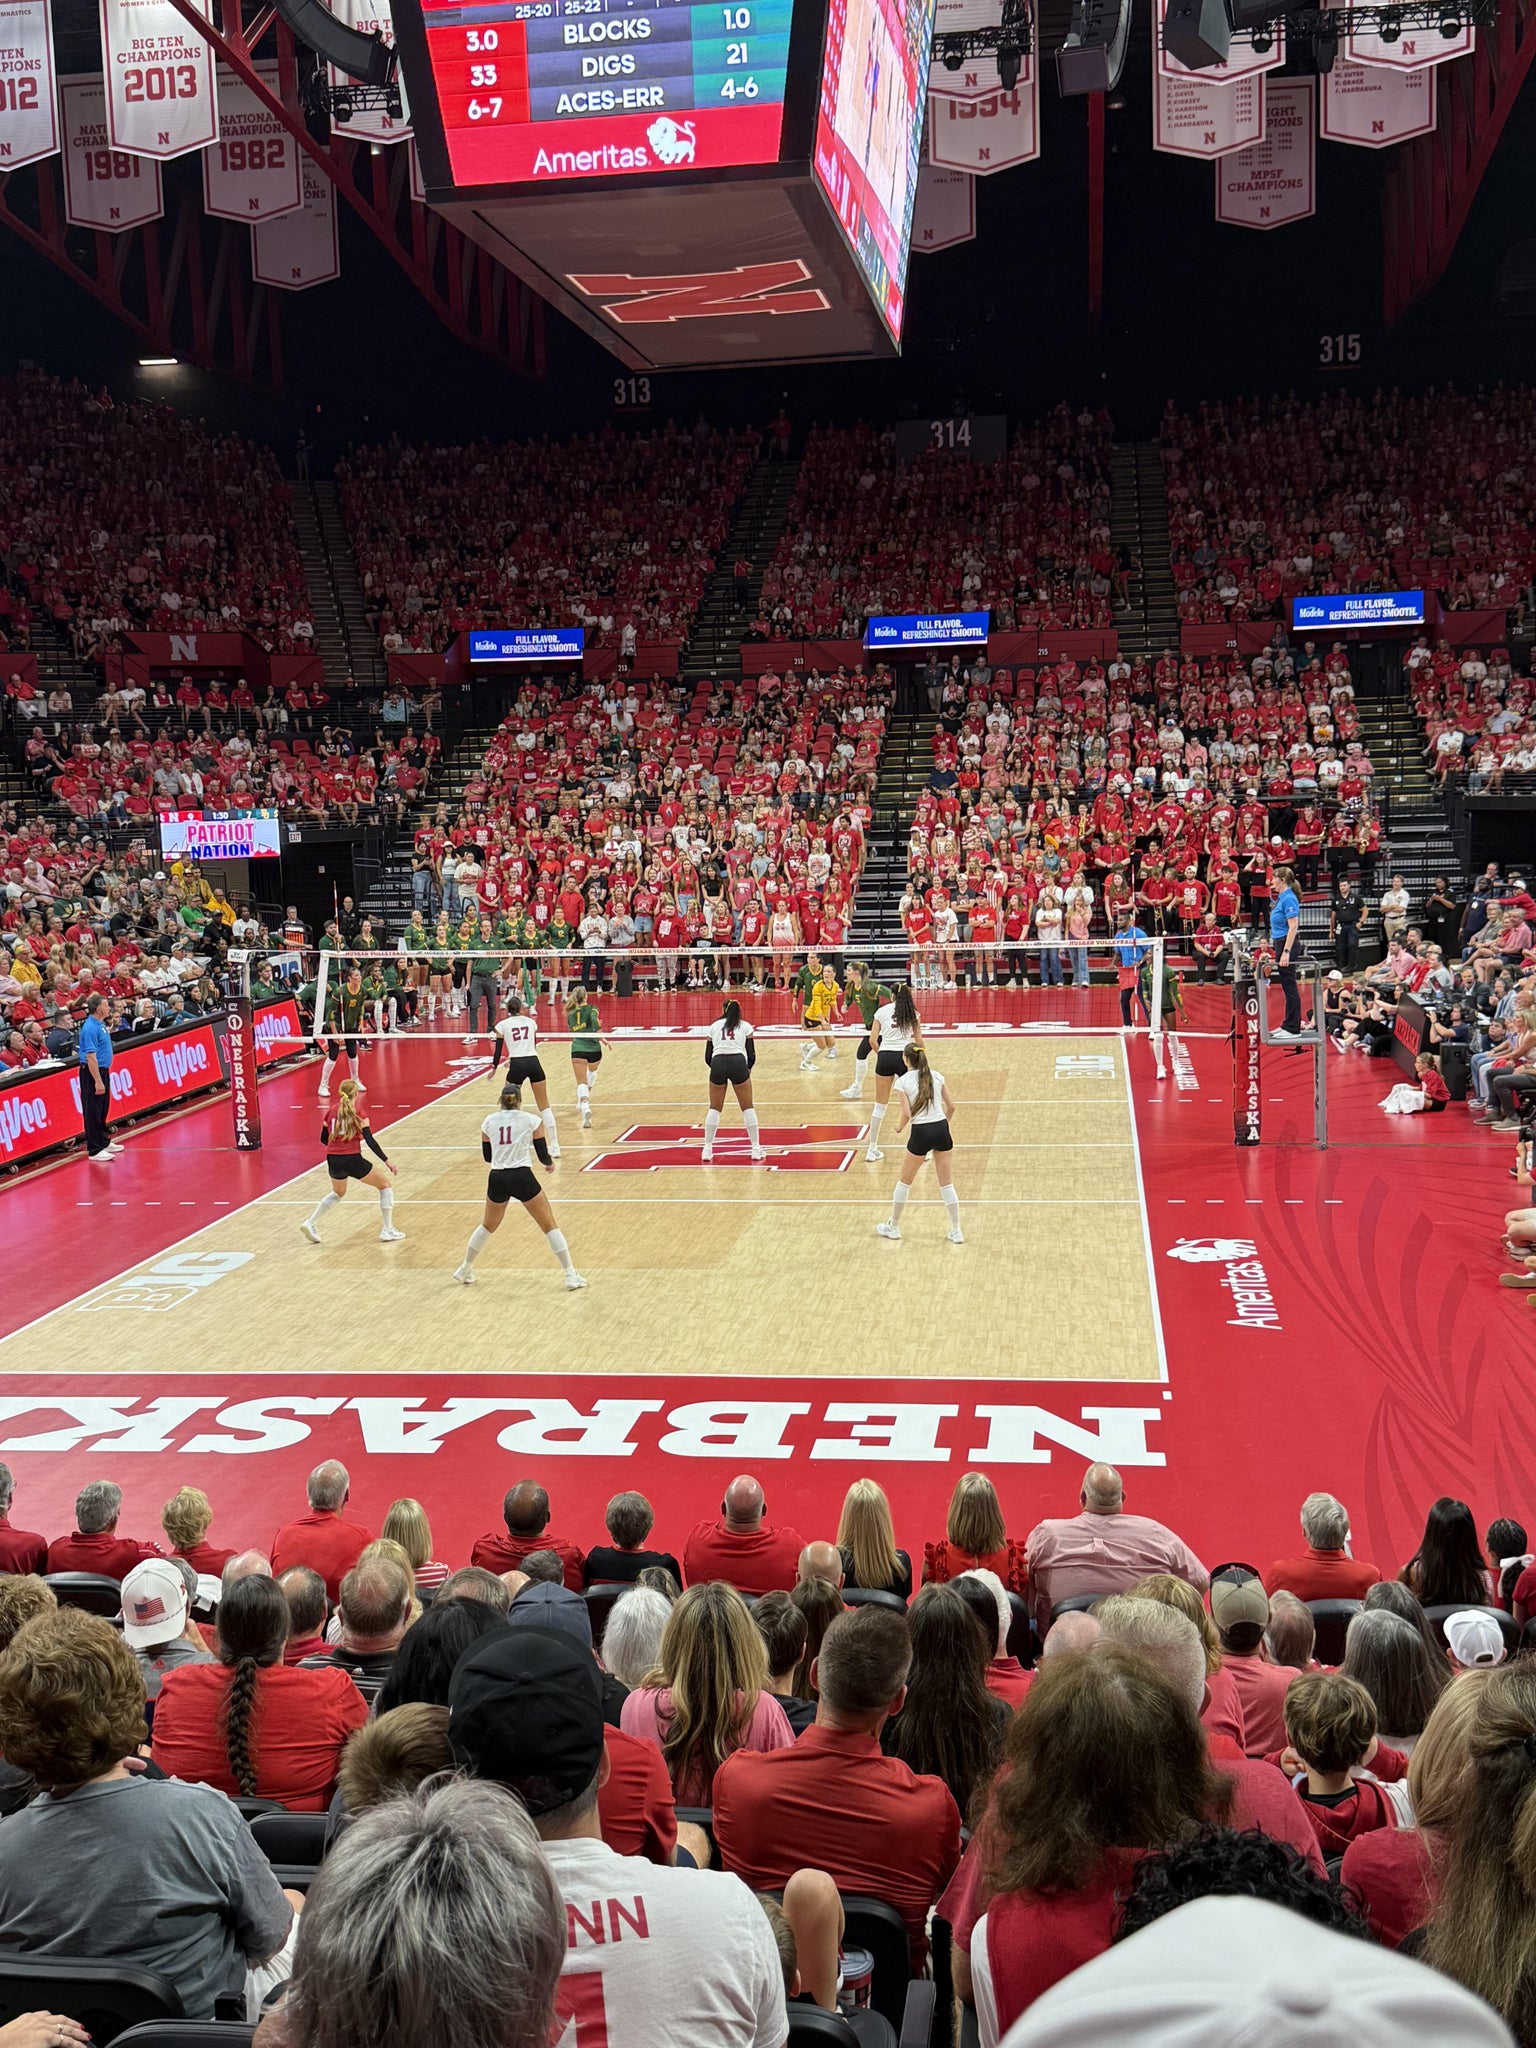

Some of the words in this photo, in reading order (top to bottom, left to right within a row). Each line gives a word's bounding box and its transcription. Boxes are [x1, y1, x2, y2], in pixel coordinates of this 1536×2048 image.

[515, 4, 552, 19] 25-20
[564, 0, 601, 14] 25-22
[356, 20, 379, 31] BIG
[723, 8, 751, 30] 1.0
[564, 18, 652, 44] BLOCKS
[132, 38, 154, 49] BIG
[158, 36, 184, 47] TEN
[466, 29, 499, 52] 3.0
[1402, 41, 1416, 55] N
[117, 47, 201, 63] CHAMPIONS
[726, 42, 748, 65] 21
[582, 54, 636, 77] DIGS
[470, 64, 497, 87] 33
[965, 73, 978, 87] N
[124, 65, 197, 103] 2013
[720, 76, 759, 99] 4-6
[557, 86, 664, 114] ACES-ERR
[468, 97, 503, 120] 6-7
[1266, 106, 1296, 117] IGHT
[219, 113, 277, 125] NATIONA
[1266, 117, 1303, 128] PIONS
[1372, 120, 1384, 133] N
[158, 132, 170, 145] N
[1204, 132, 1216, 144] N
[219, 139, 285, 171] 1982
[533, 145, 648, 175] Ameritas
[978, 148, 990, 160] N
[85, 149, 140, 181] 1981
[1227, 179, 1303, 192] CHAMPIONS
[249, 198, 259, 209] N
[110, 208, 120, 219] N
[1260, 207, 1270, 218] N
[1319, 333, 1361, 363] 315
[614, 378, 651, 405] 313
[930, 419, 972, 448] 314
[1300, 606, 1324, 618] Modelo
[1345, 600, 1363, 610] FULL
[1364, 599, 1396, 608] FLAVOR.
[1329, 609, 1381, 620] REFRESHINGLY
[875, 626, 897, 637] Modelo
[917, 621, 933, 630] FULL
[934, 619, 964, 629] FLAVOR.
[516, 636, 532, 644] FULL
[532, 635, 560, 644] FLAVOR.
[902, 629, 950, 640] REFRESHINGLY
[169, 635, 198, 661] N
[475, 640, 497, 651] Modelo
[502, 643, 548, 654] REFRESHINGLY
[188, 823, 254, 842] PATRIOT
[191, 843, 250, 858] NATION
[511, 1026, 529, 1042] 27
[721, 1028, 735, 1041] 14
[153, 1041, 207, 1088] HyVee
[1247, 1020, 1260, 1140] NEBRASKA
[229, 1034, 251, 1146] NEBRASKA
[499, 1126, 512, 1145] 11
[1226, 1261, 1283, 1331] Ameritas
[0, 1396, 1167, 1467] NEBRASK
